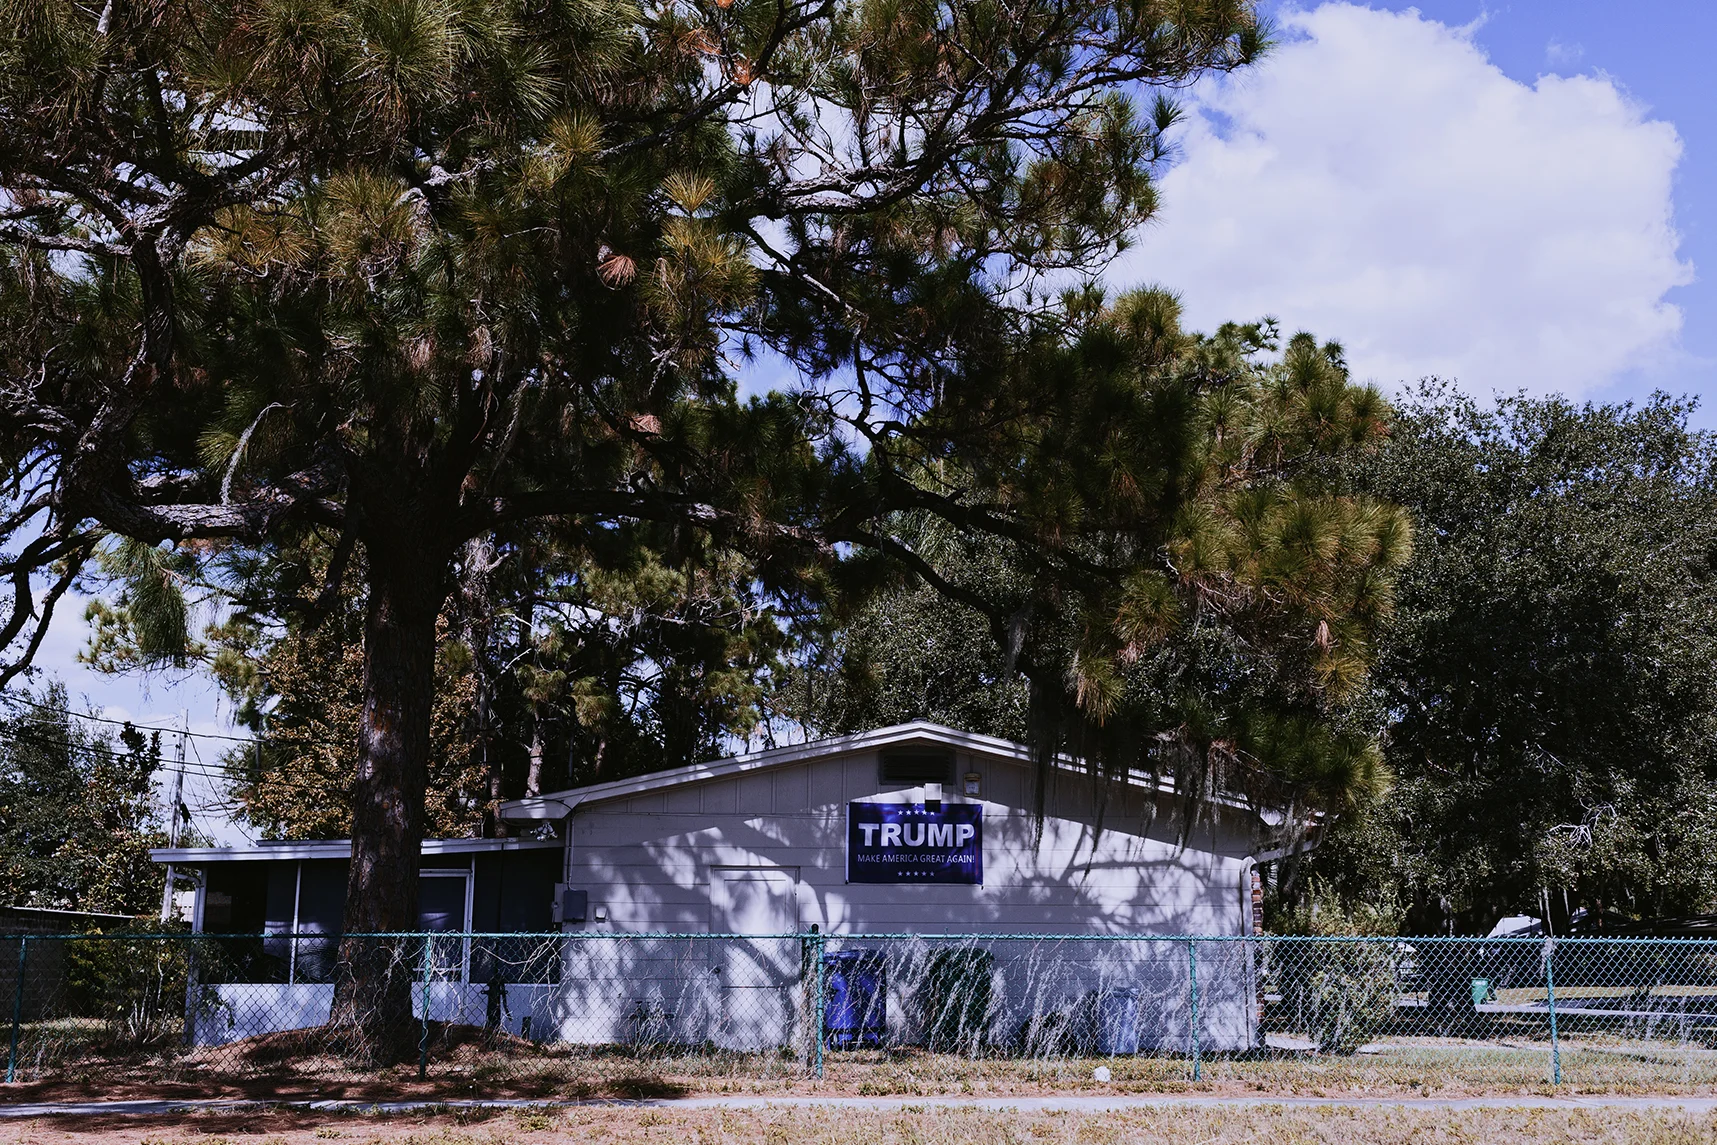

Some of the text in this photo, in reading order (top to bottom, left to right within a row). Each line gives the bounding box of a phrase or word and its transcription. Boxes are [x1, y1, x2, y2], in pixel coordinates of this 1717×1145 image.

[858, 823, 975, 847] TRUMP
[857, 854, 975, 863] MAKE AMERICA GREAT AGAIN!
